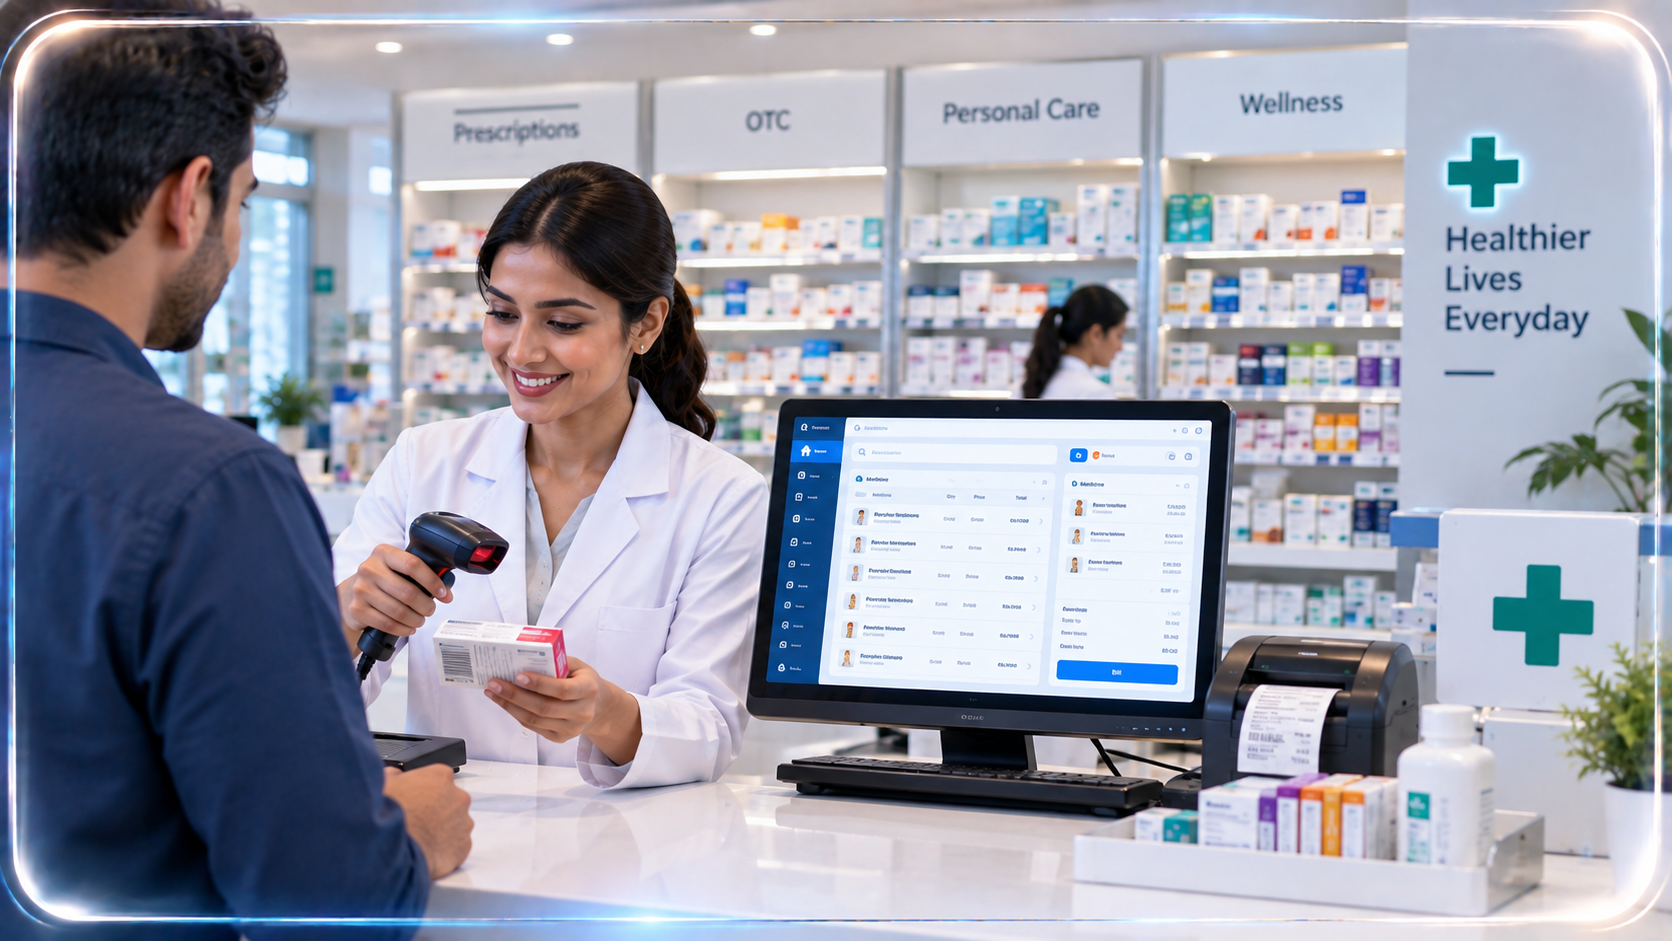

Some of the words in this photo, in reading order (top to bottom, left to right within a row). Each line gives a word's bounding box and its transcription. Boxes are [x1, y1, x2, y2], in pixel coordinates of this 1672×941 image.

[943, 98, 1040, 124] Personal
[1046, 97, 1101, 121] Care
[1239, 91, 1344, 115] Wellness
[453, 119, 581, 146] Prescriptions
[745, 109, 791, 132] OTC
[1446, 223, 1591, 252] Healthier
[1446, 265, 1522, 291] Lives
[1446, 303, 1590, 338] Everyday
